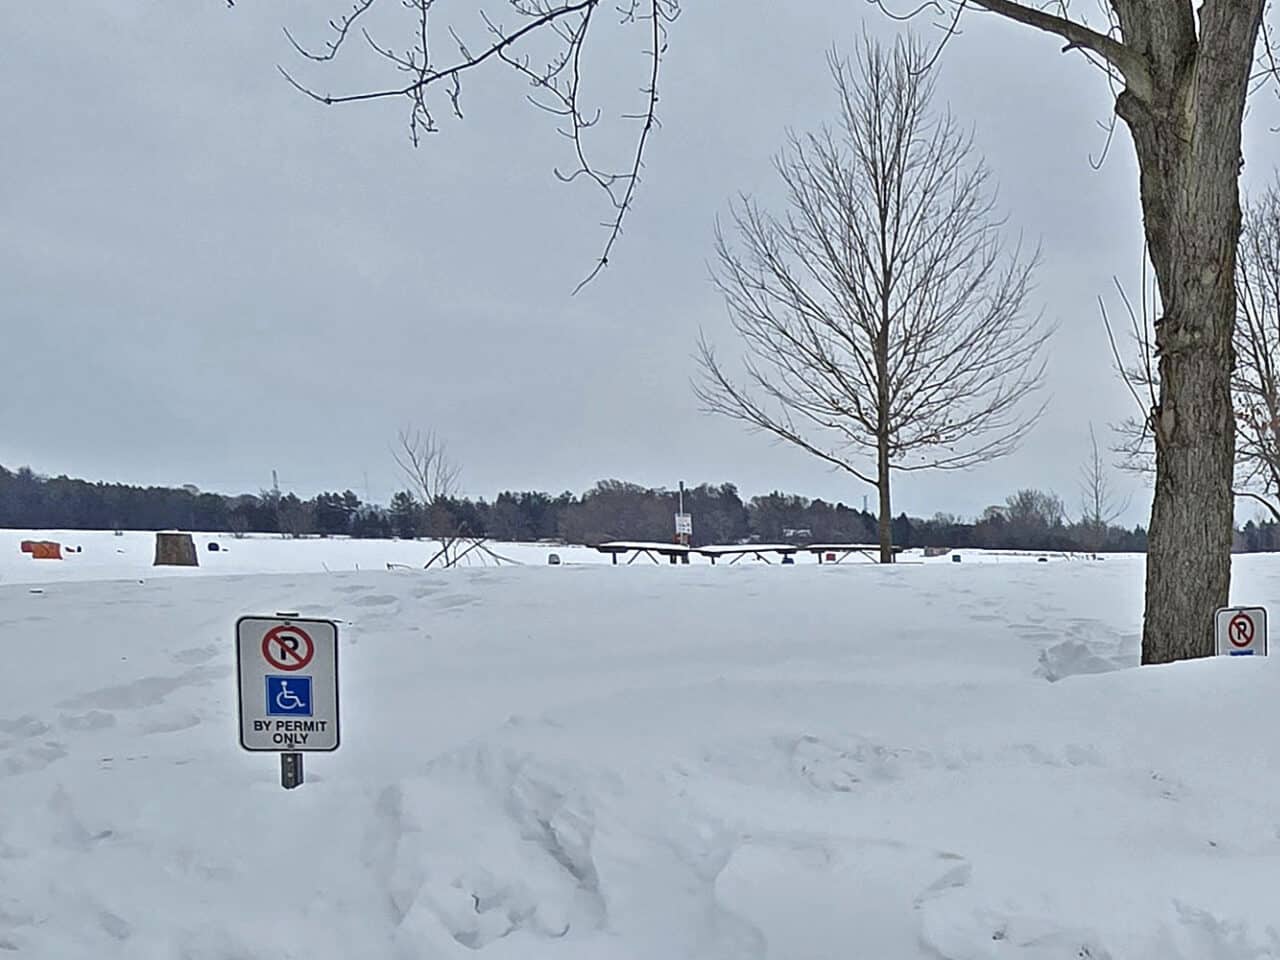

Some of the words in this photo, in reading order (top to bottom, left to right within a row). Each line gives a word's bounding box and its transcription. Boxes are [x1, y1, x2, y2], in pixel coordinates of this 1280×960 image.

[254, 720, 272, 731] BY
[276, 720, 327, 732] PERMIT
[272, 732, 309, 744] ONLY
